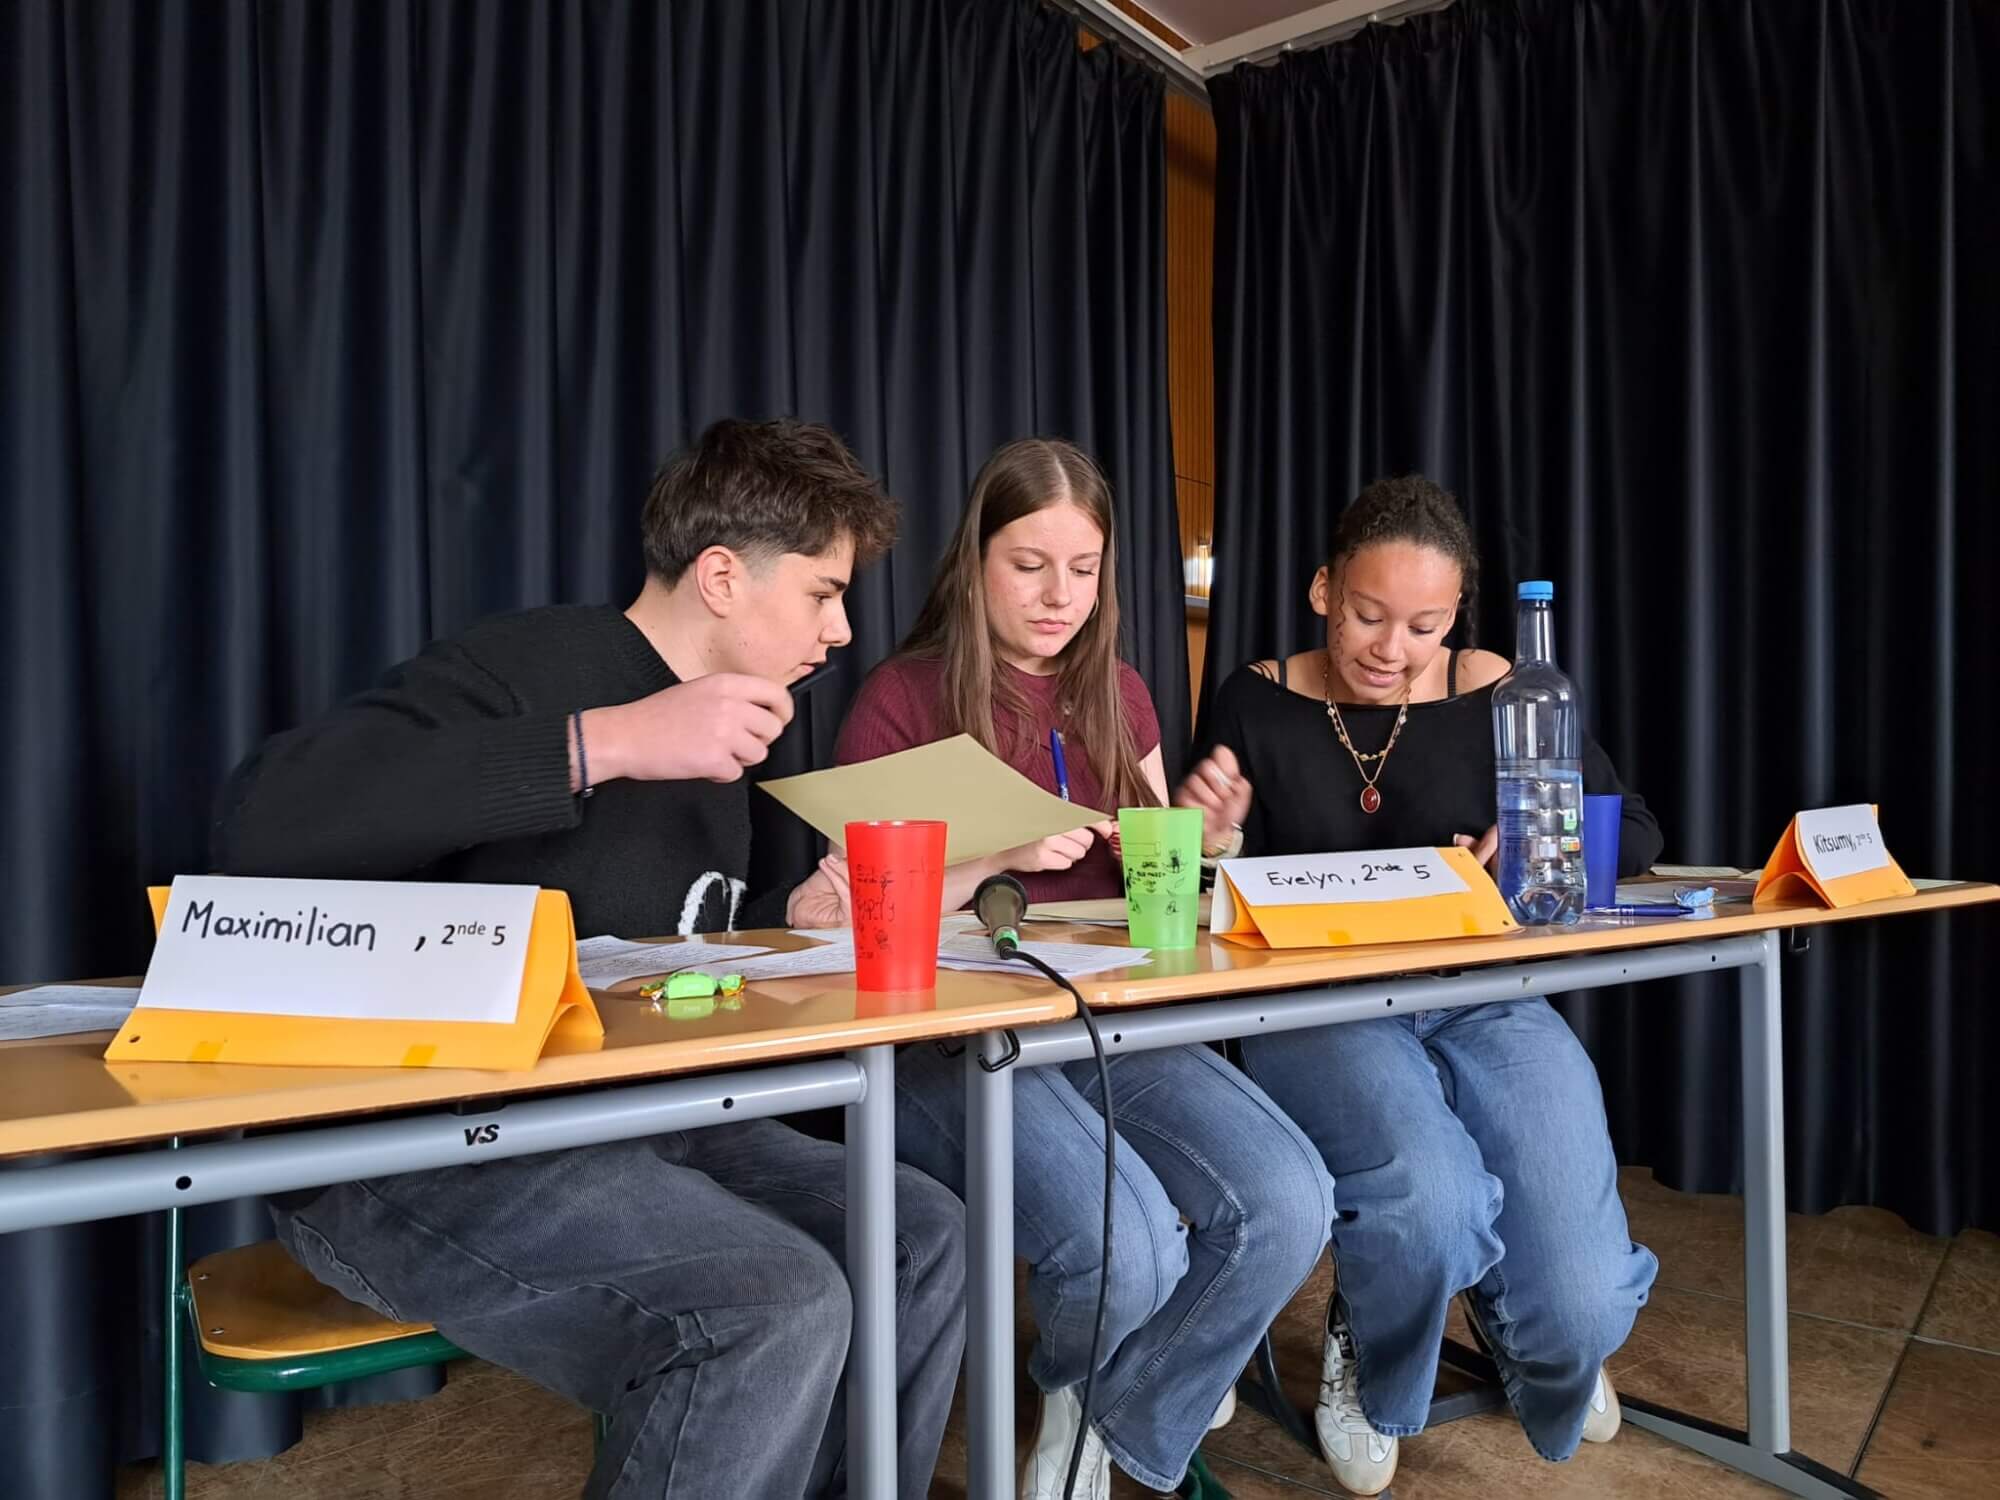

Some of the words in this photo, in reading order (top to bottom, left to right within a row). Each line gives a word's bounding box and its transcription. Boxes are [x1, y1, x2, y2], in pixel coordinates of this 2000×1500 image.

[1413, 864, 1431, 880] 5
[182, 900, 376, 951] Maximilian
[491, 925, 506, 946] 5
[464, 1124, 500, 1147] VS
